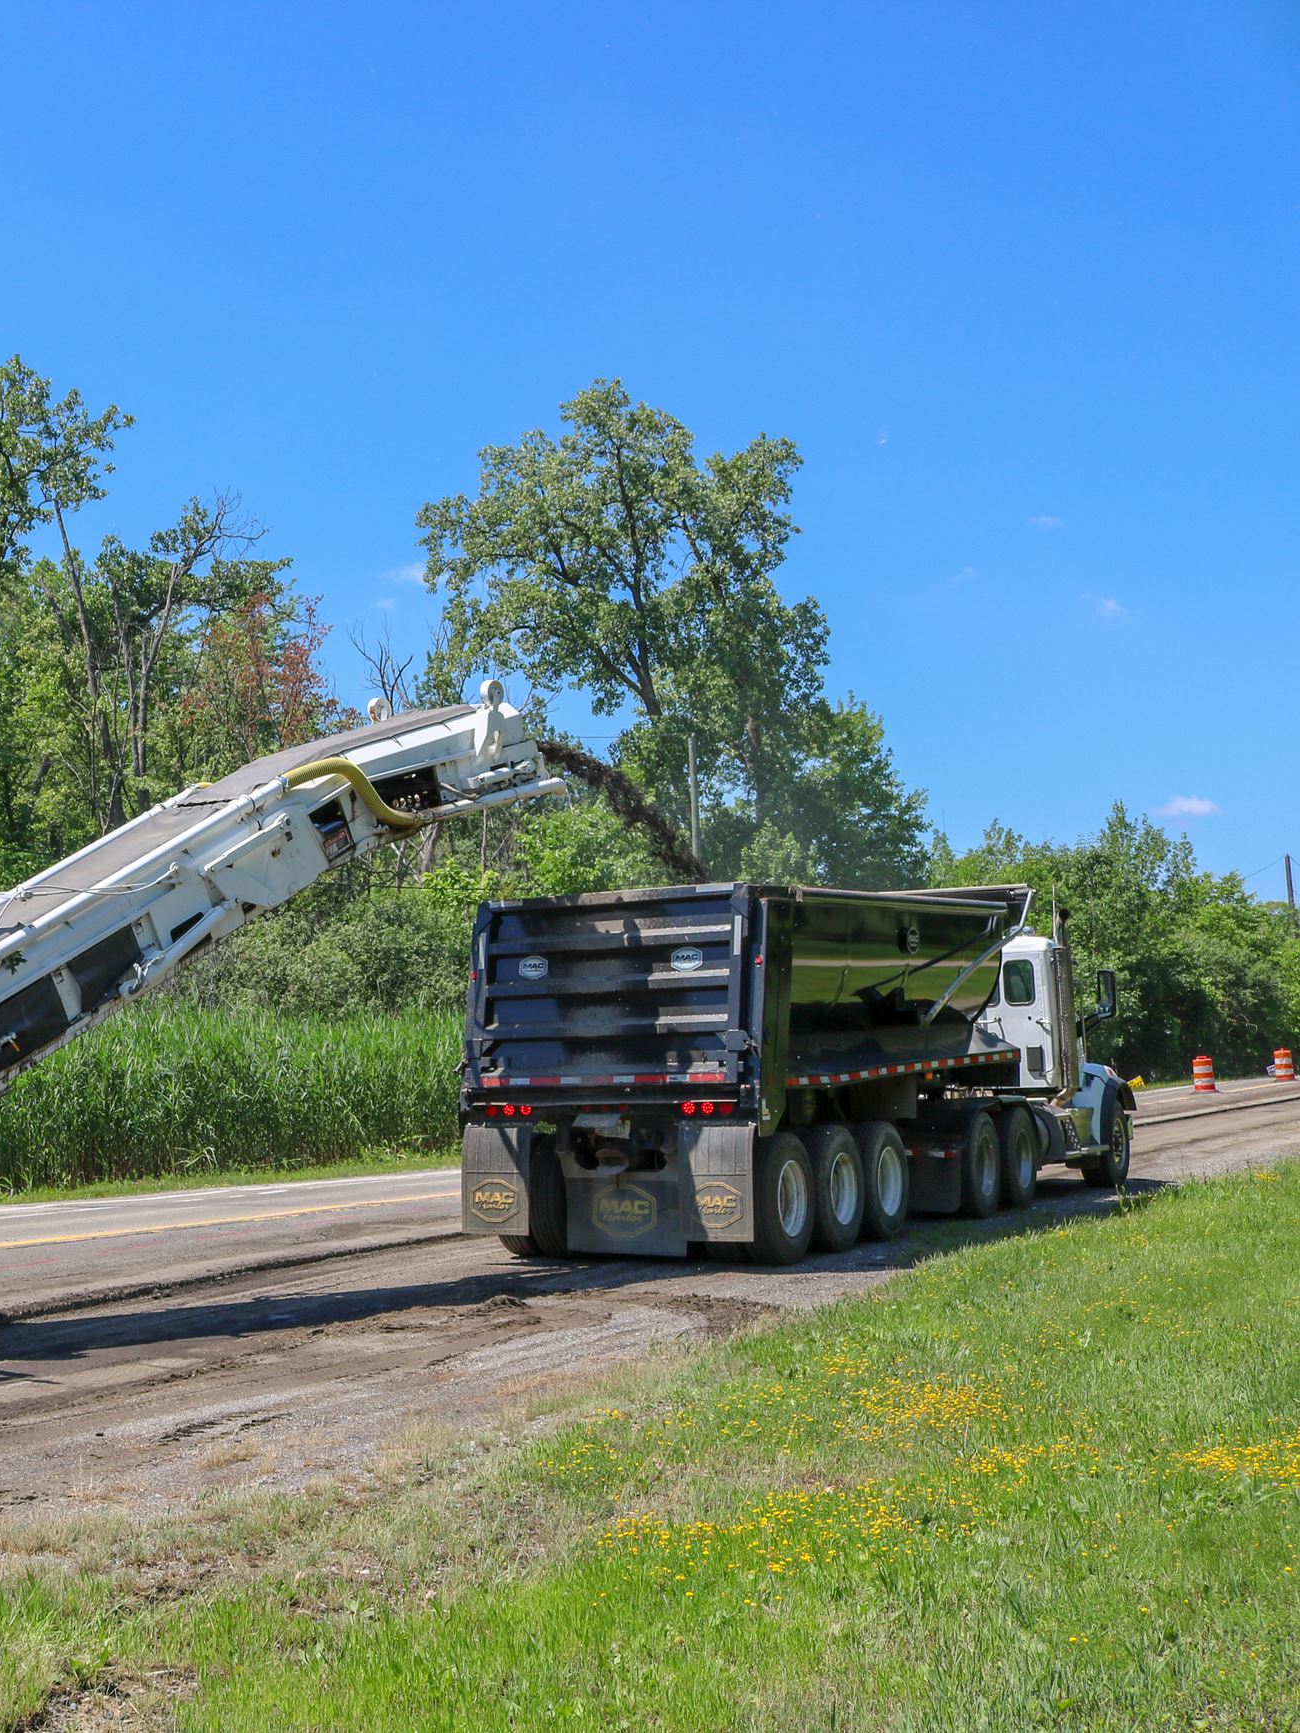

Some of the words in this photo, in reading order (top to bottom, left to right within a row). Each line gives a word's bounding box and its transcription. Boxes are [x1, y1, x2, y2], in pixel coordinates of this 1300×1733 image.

[475, 1191, 514, 1204] MAC
[695, 1195, 737, 1208] MAC
[600, 1199, 650, 1214] MAC
